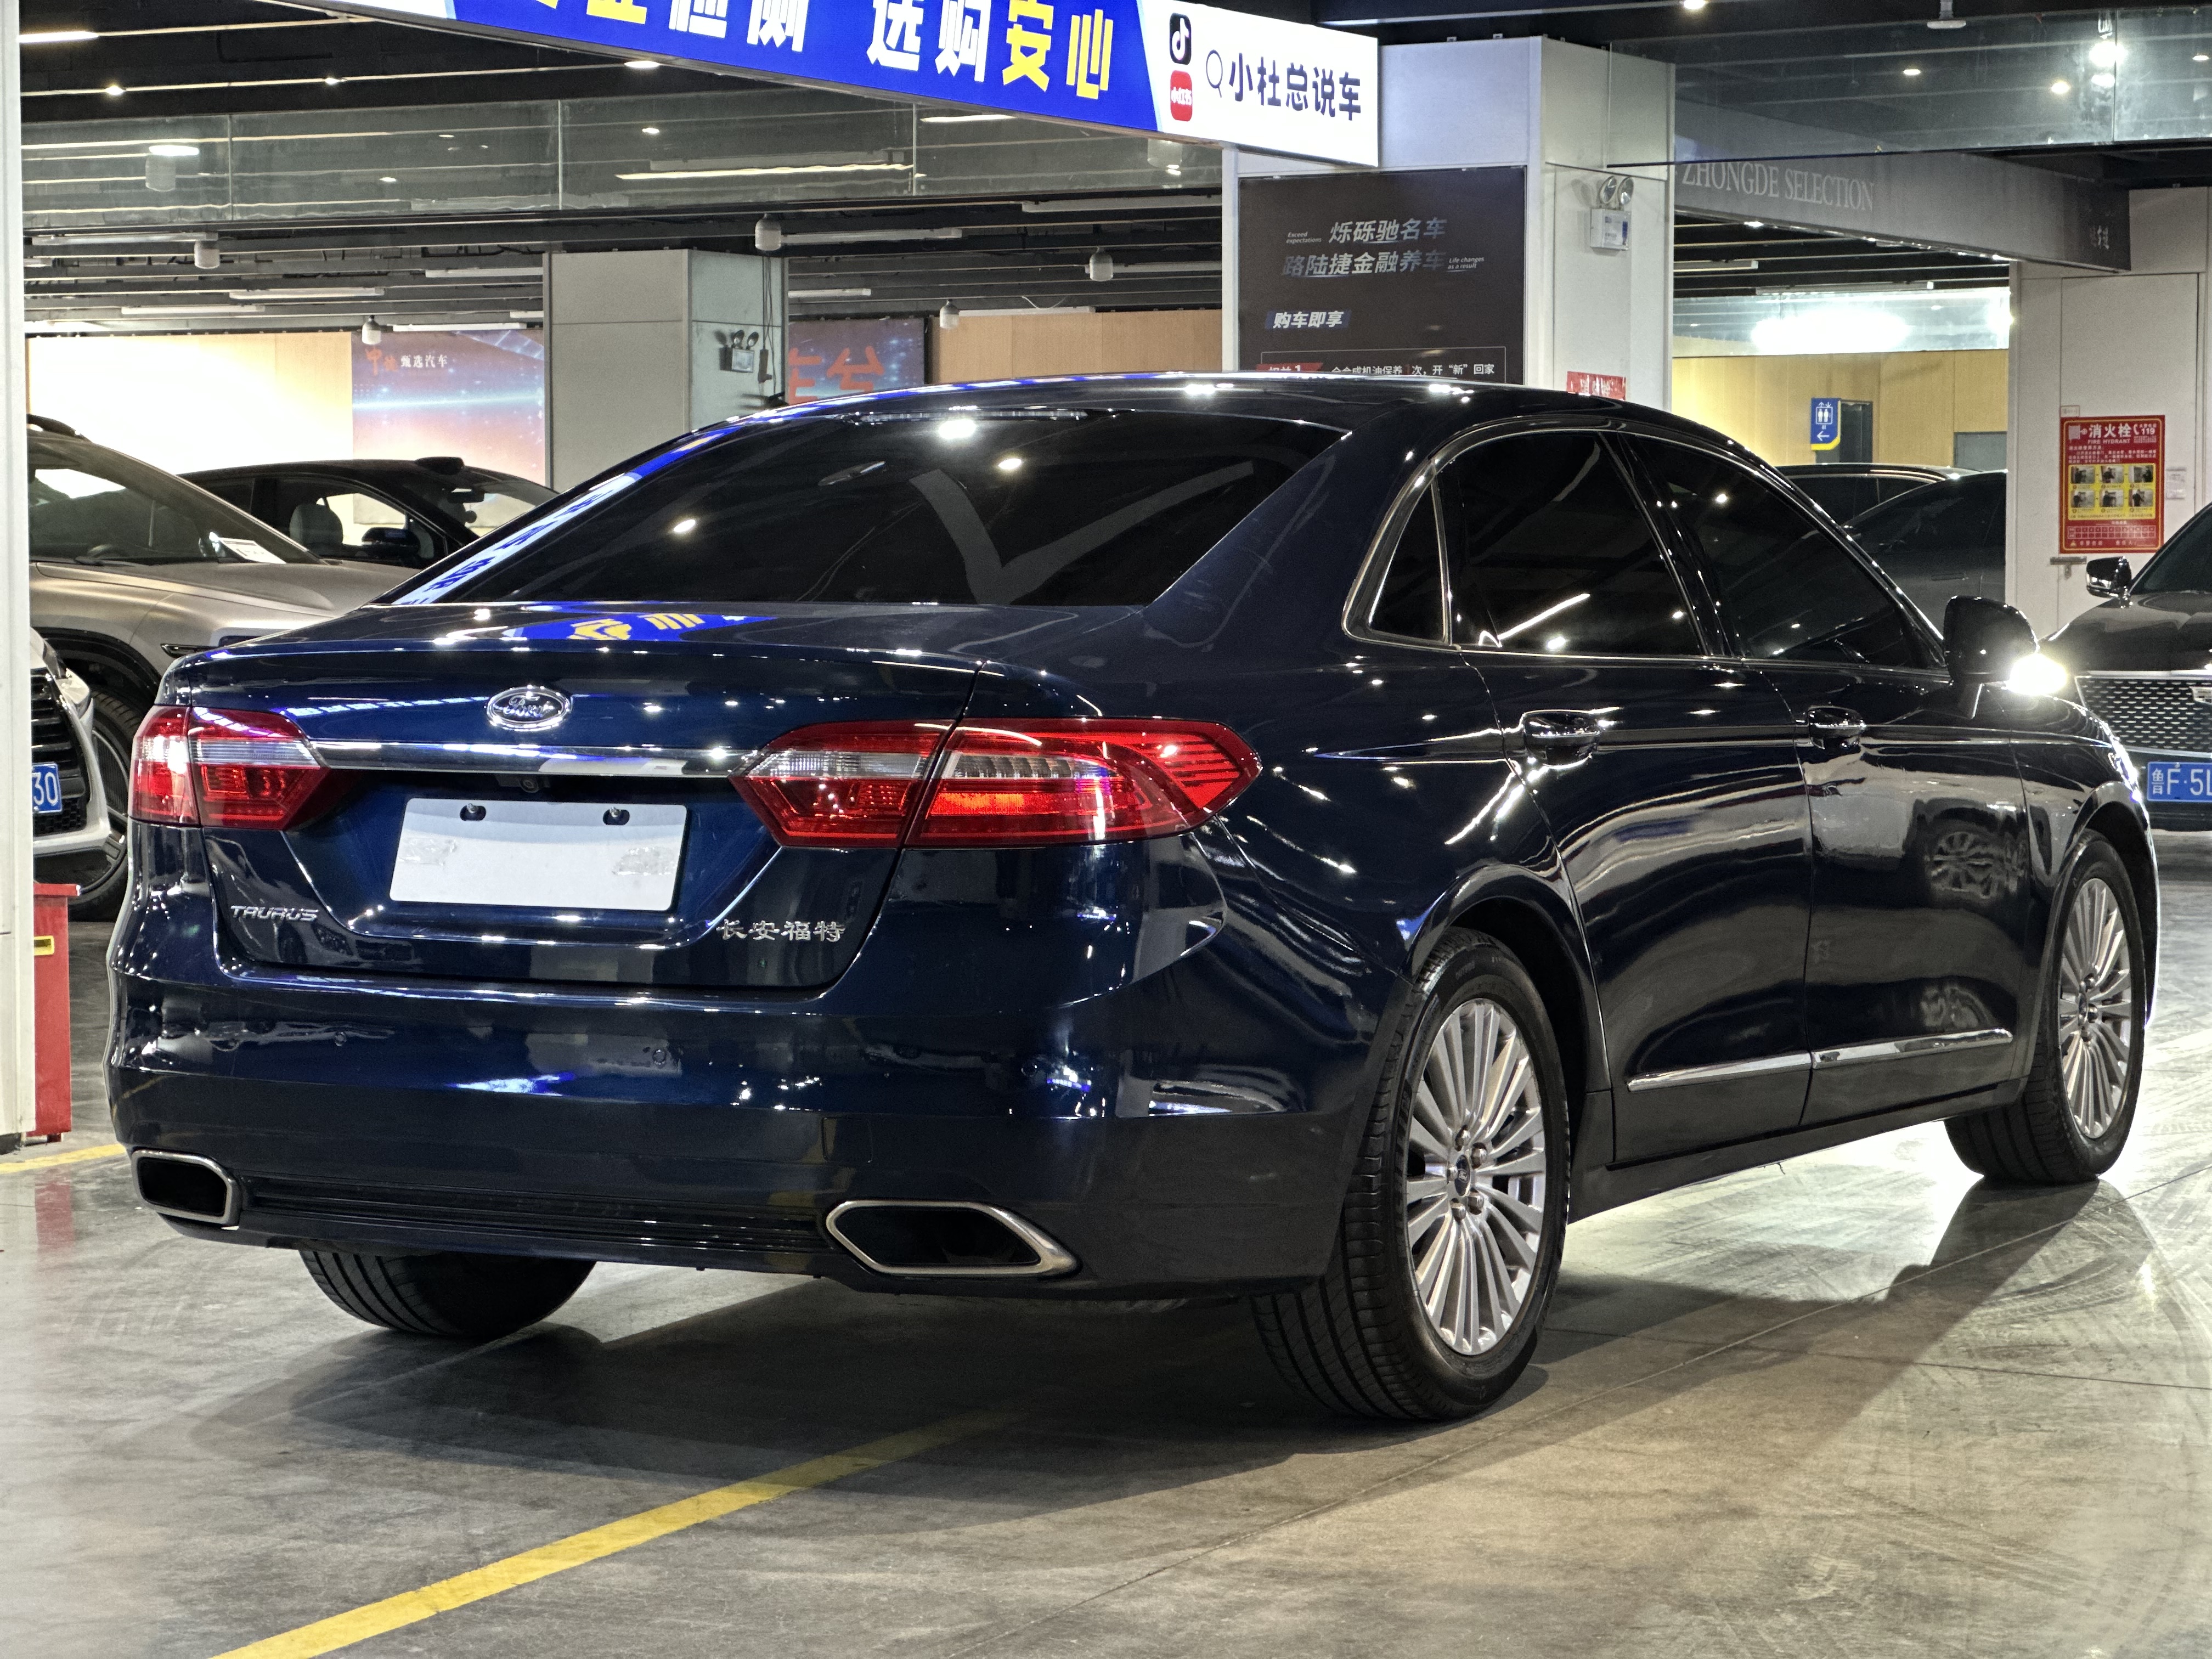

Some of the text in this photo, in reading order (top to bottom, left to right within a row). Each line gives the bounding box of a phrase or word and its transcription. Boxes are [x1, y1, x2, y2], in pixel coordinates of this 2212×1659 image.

[866, 0, 1113, 99] 选购安心
[1229, 53, 1361, 121] 小杜总说车
[1682, 162, 1874, 211] ZHONGDE SELECTION
[1329, 218, 1447, 243] 烁砾驰名车
[1273, 310, 1344, 329] 购车即享
[2089, 423, 2131, 438] 消火栓
[230, 905, 319, 921] TAURUS
[716, 918, 845, 941] 长安福特
